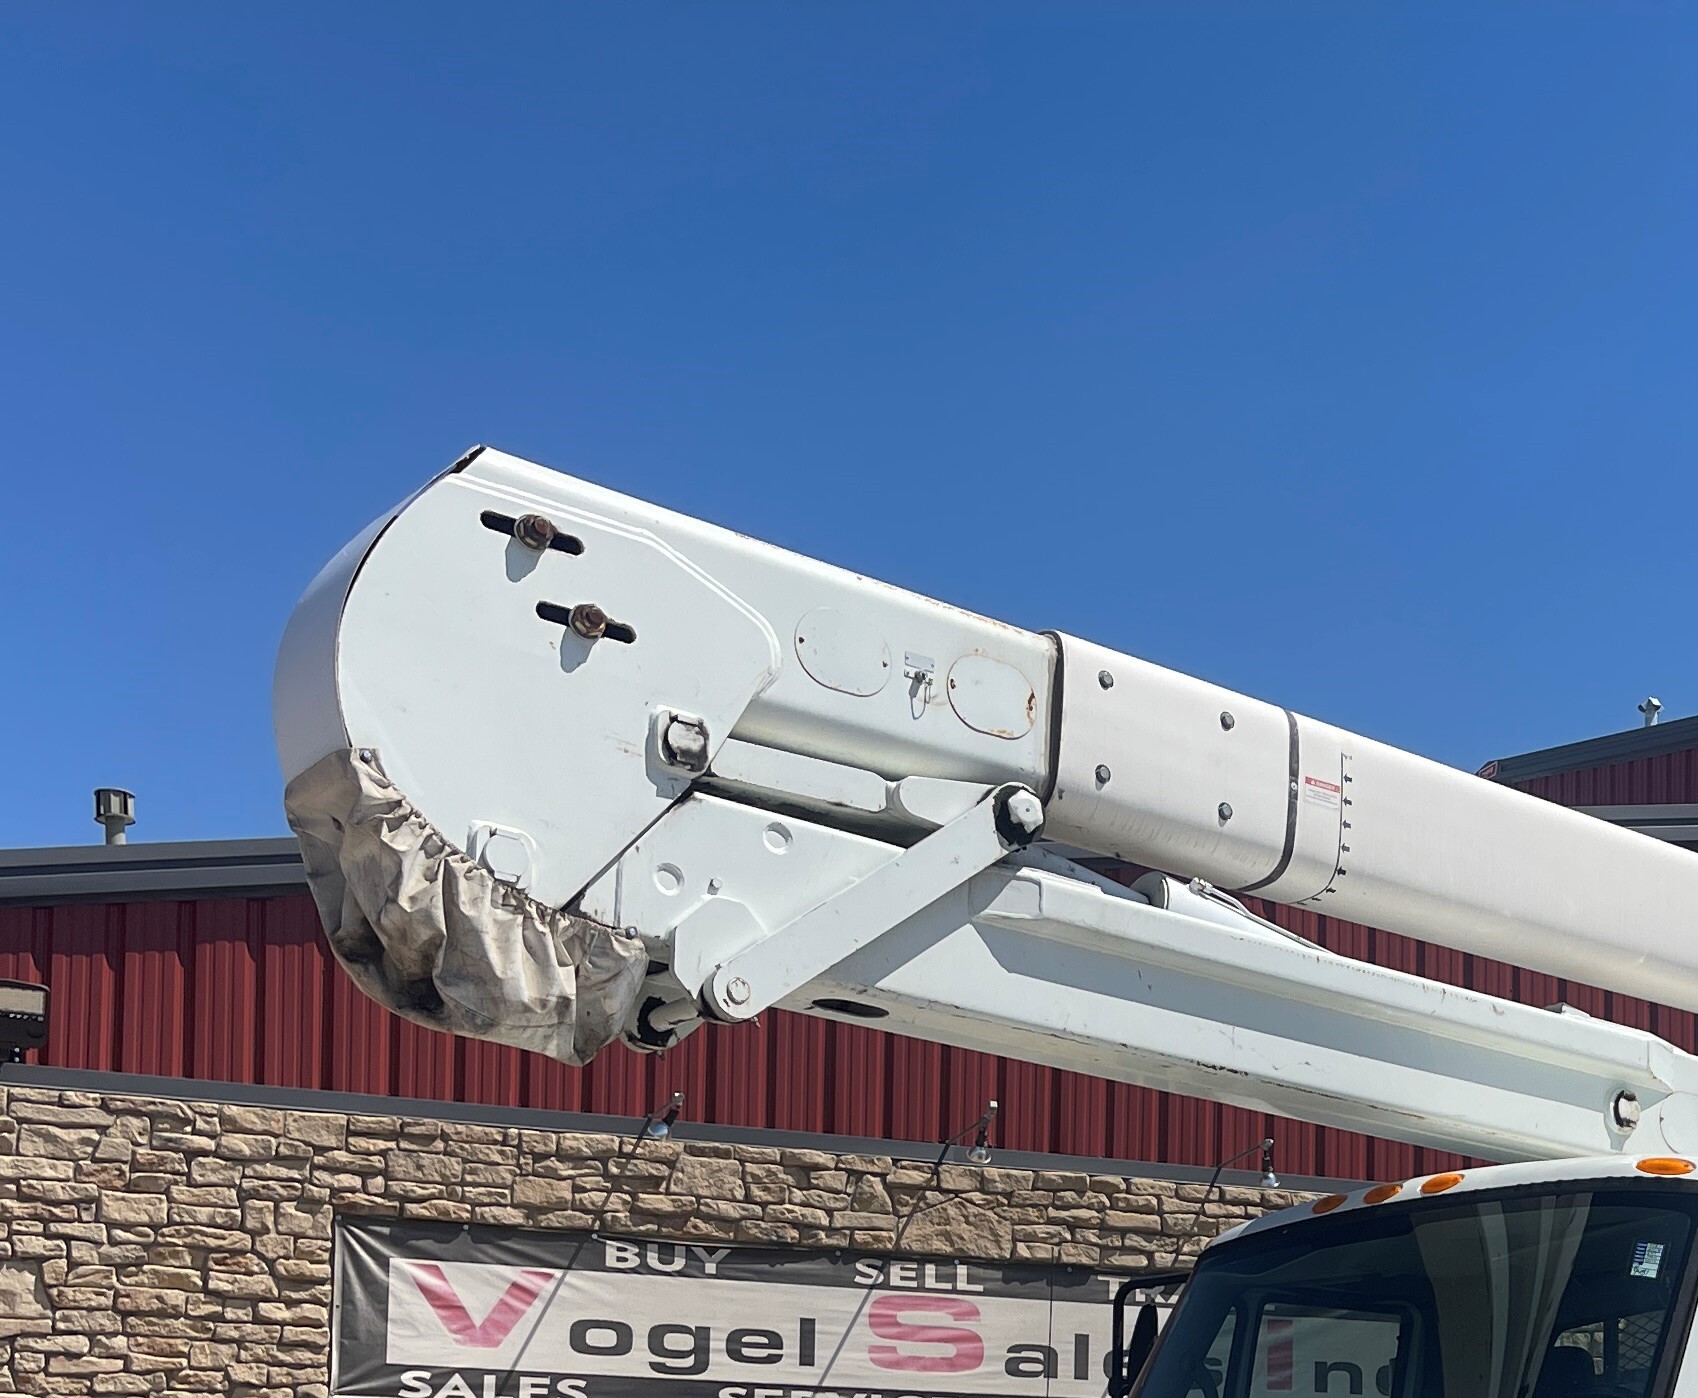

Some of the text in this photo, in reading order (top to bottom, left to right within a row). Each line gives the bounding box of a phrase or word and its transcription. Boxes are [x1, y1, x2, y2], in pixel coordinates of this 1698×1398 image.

[604, 1239, 985, 1293] BUY SELL
[404, 1262, 817, 1376] Vogel
